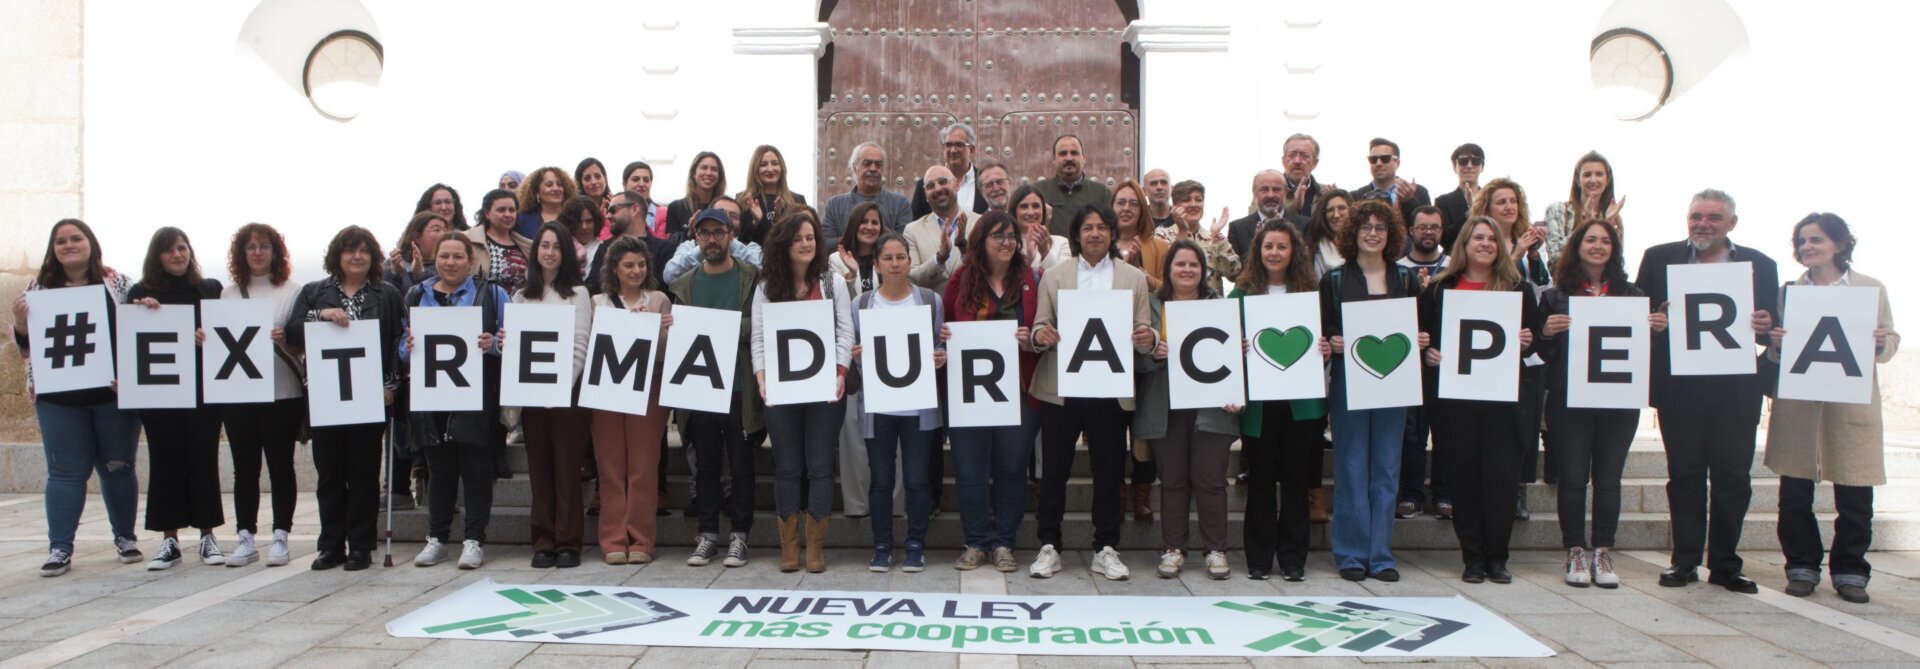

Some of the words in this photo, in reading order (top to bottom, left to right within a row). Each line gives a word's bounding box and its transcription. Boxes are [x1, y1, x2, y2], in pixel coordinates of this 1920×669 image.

[1065, 317, 1126, 374] A
[1457, 318, 1507, 375] P
[1684, 292, 1742, 351] R
[1789, 316, 1863, 377] A
[135, 331, 181, 386] E
[213, 325, 264, 381] X
[320, 346, 366, 402] T
[423, 334, 471, 388] R
[518, 330, 559, 384] E
[587, 333, 652, 392] M
[669, 334, 725, 390] A
[776, 328, 826, 383] D
[873, 332, 922, 389] U
[960, 348, 1009, 404] R
[1179, 326, 1232, 384] C
[1587, 325, 1633, 384] E
[699, 615, 834, 638] más
[846, 621, 1215, 648] cooperación
[718, 595, 926, 617] NUEVA
[942, 599, 1055, 620] LEY
